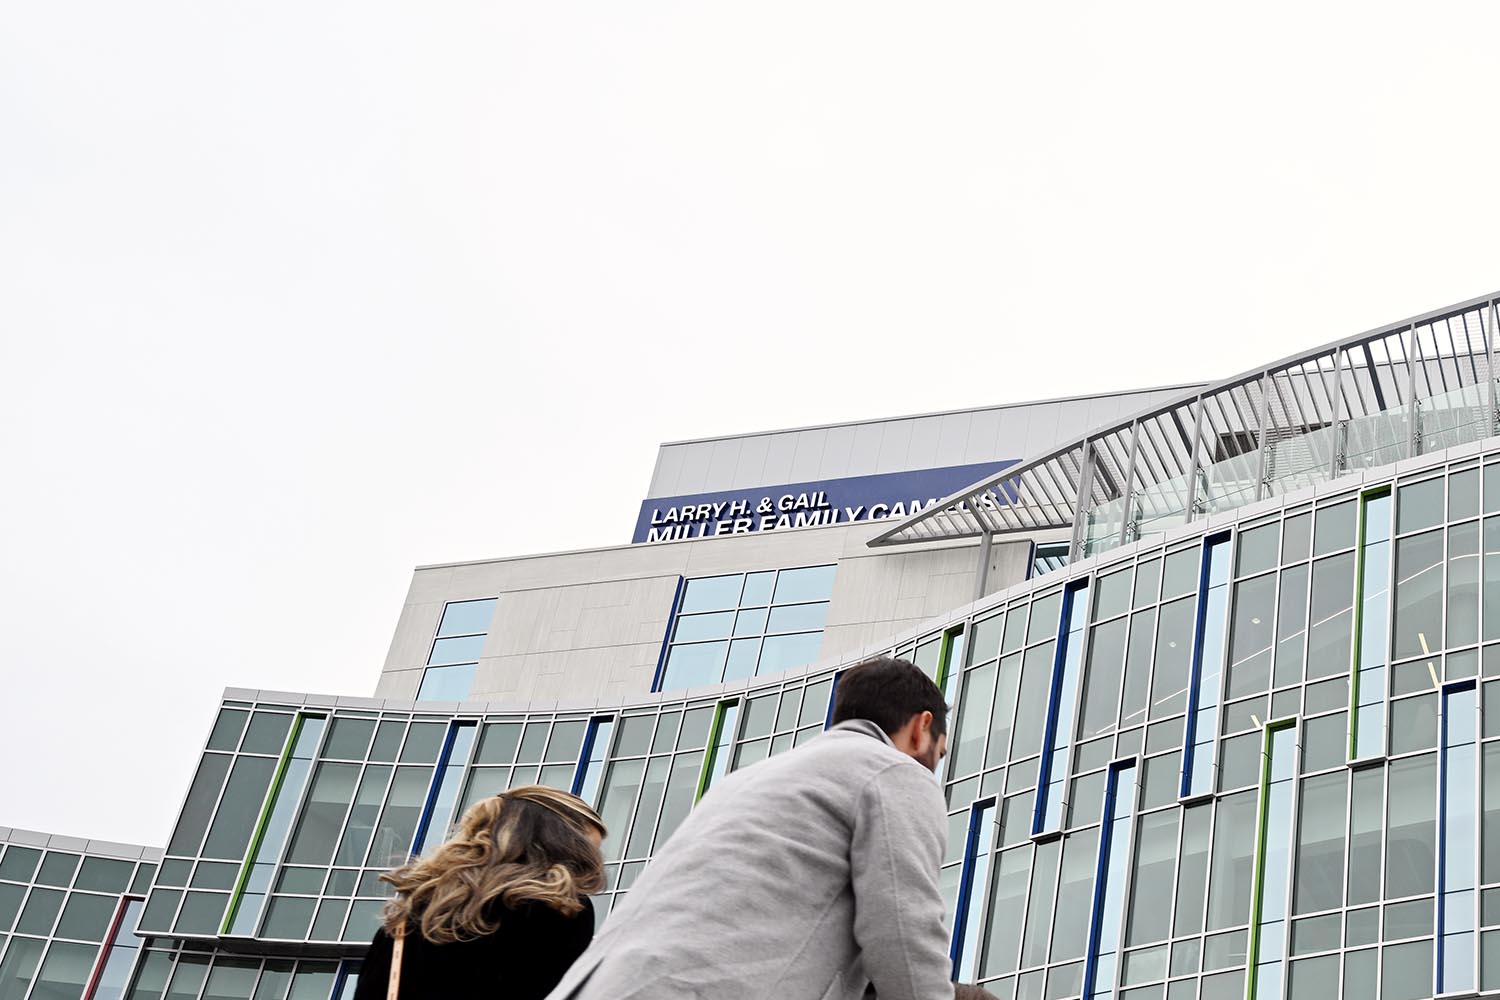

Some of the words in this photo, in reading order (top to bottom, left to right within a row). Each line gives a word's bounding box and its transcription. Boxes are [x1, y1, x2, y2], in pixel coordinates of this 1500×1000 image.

[650, 501, 728, 525] LARRY
[729, 499, 752, 517] H.
[756, 496, 773, 513] &
[777, 491, 830, 511] GAIL
